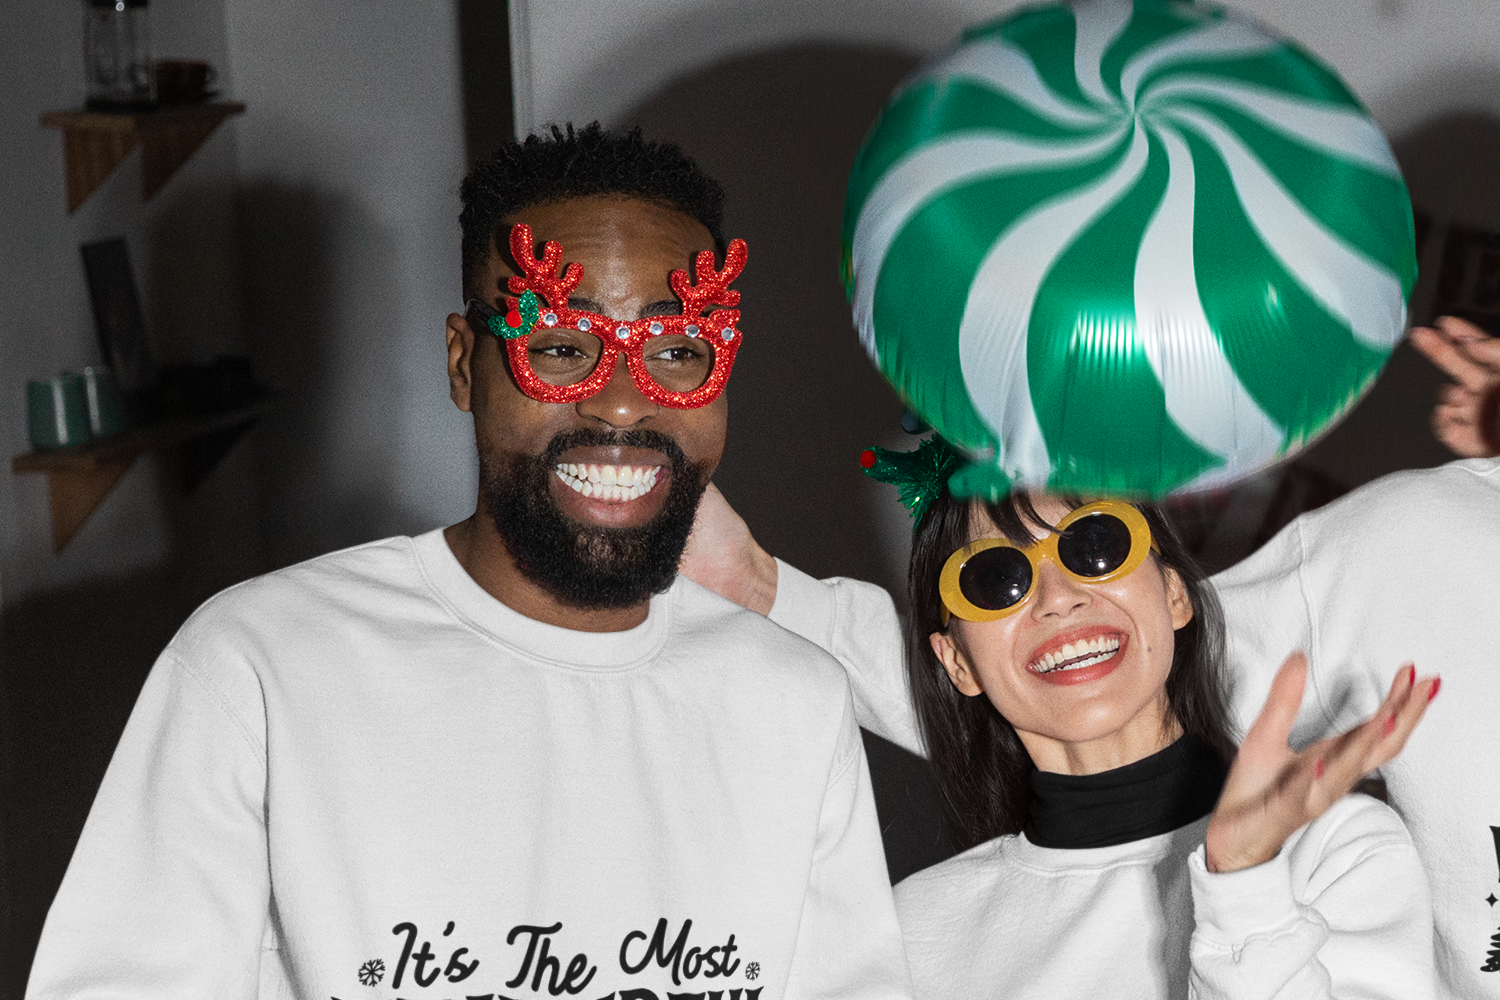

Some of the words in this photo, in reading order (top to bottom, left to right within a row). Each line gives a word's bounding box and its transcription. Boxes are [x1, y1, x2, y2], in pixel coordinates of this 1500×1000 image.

[392, 921, 479, 990] It's
[506, 921, 597, 997] The
[619, 917, 741, 987] Most
